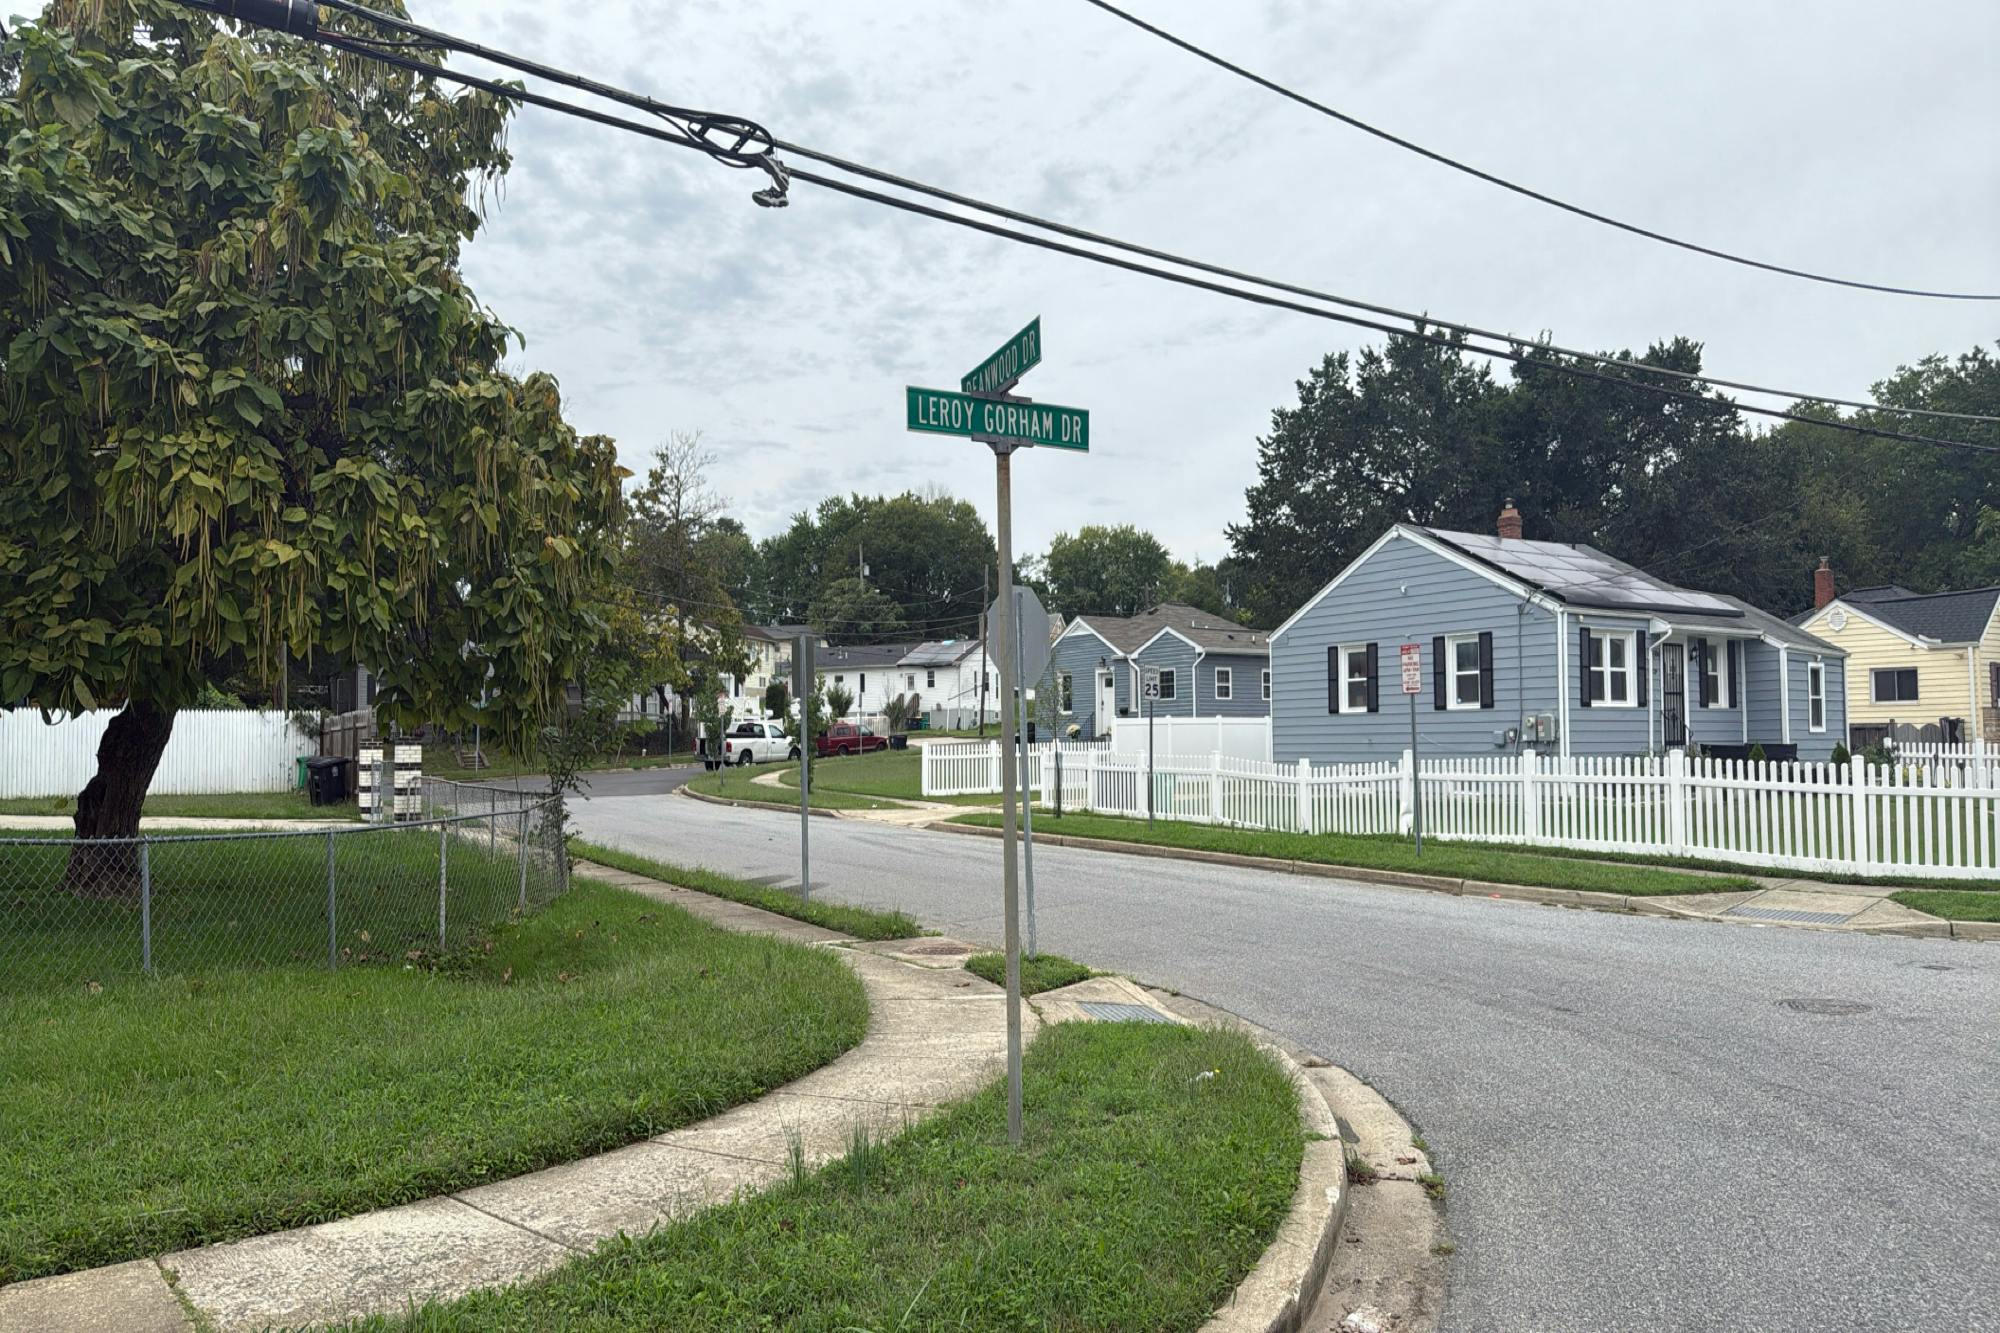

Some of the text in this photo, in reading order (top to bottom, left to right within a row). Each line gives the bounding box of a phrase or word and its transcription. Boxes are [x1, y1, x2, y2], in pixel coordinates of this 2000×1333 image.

[1022, 330, 1036, 365] DR
[917, 395, 1082, 444] LEROY GORHAM DR
[1145, 667, 1159, 675] SPEED
[1145, 683, 1159, 698] 25
